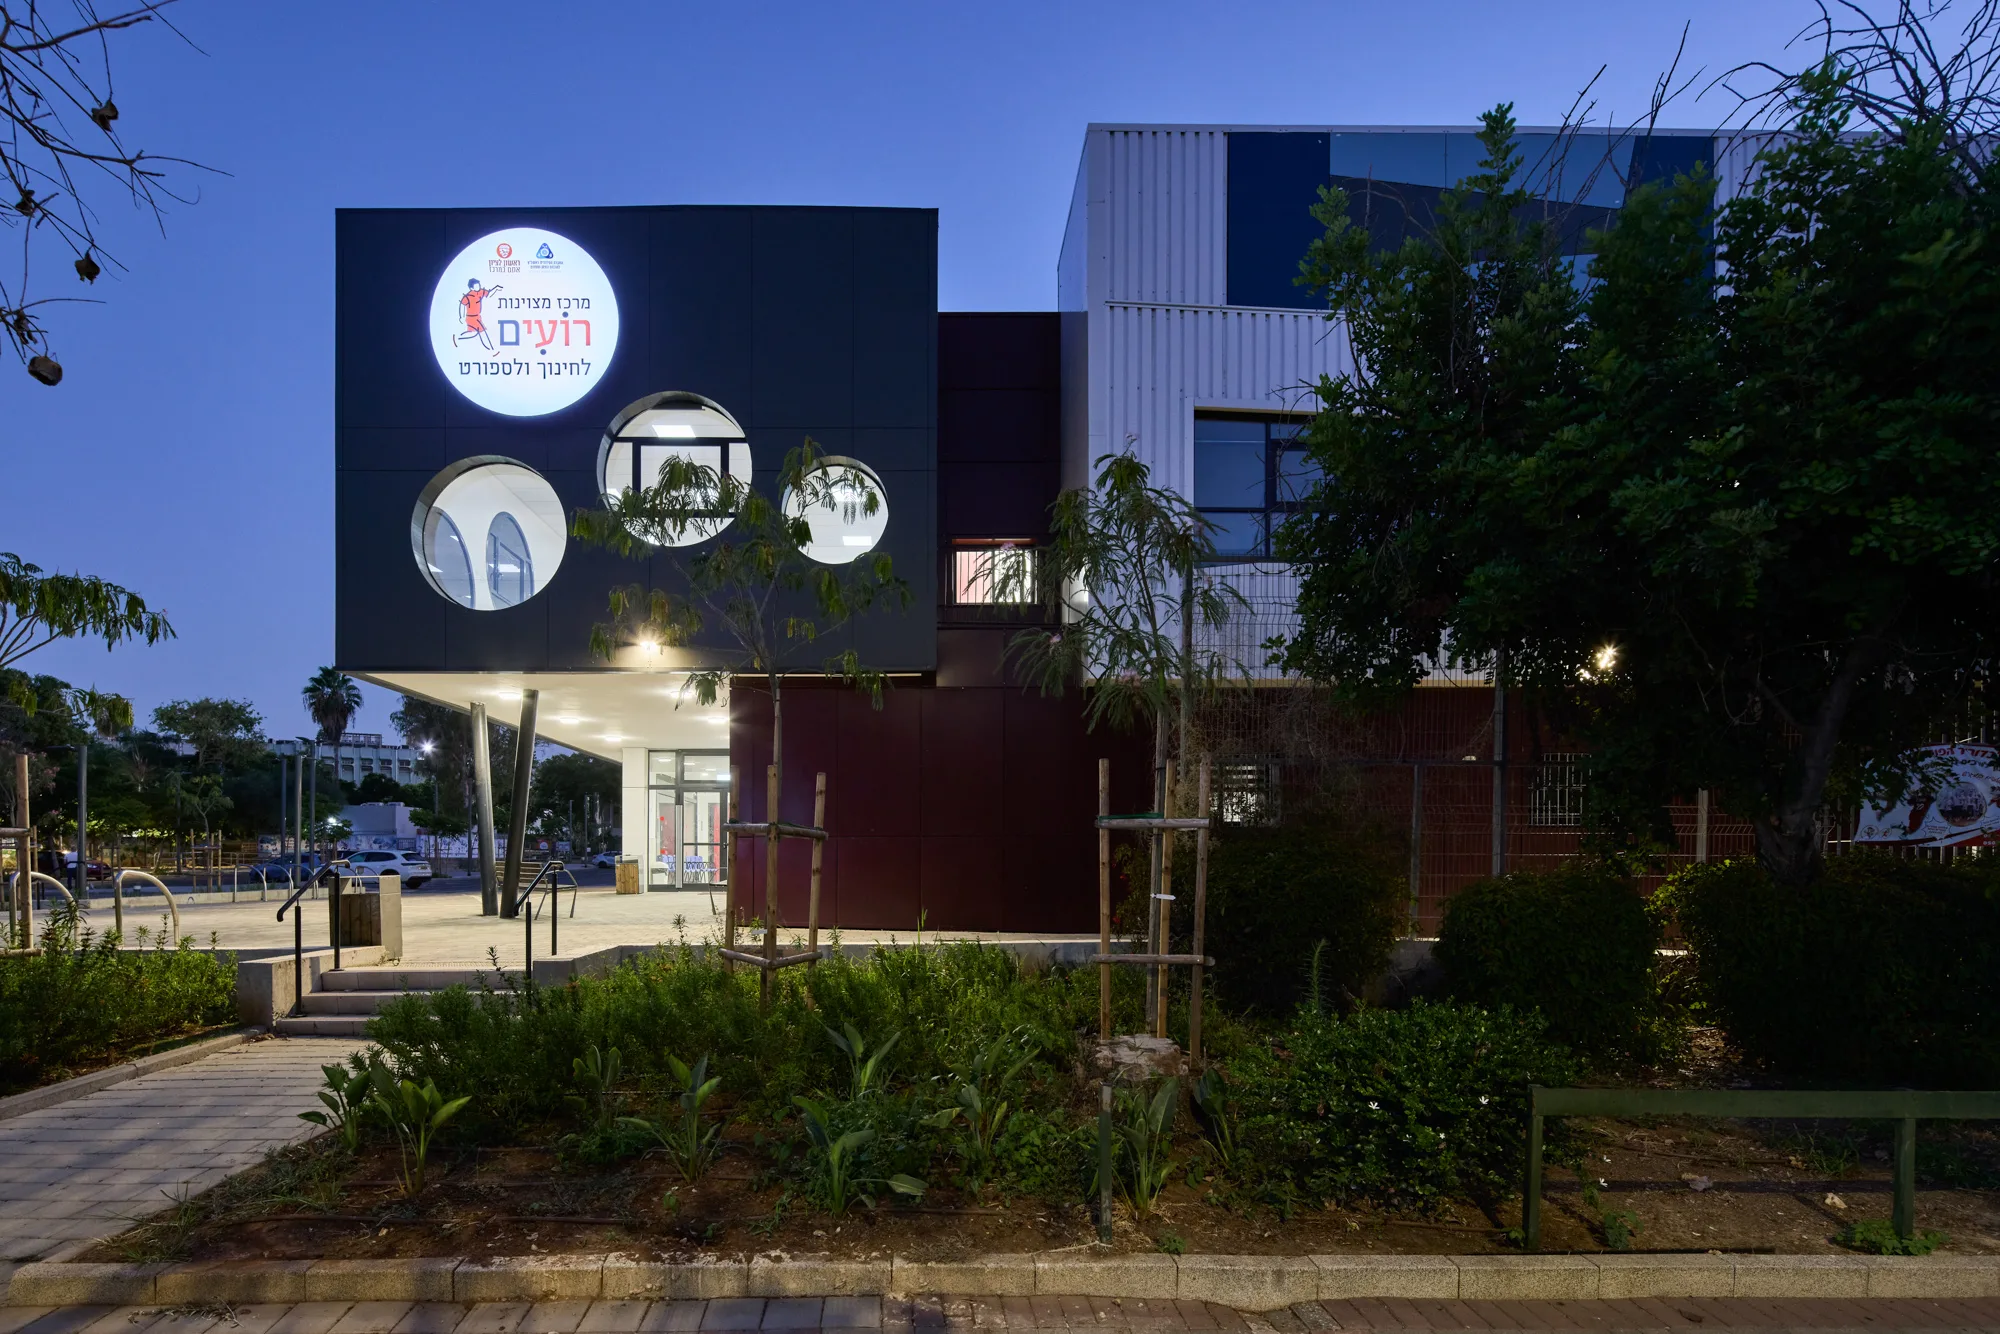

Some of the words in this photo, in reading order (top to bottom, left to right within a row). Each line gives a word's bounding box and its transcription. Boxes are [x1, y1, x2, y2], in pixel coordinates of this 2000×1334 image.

[498, 298, 552, 310] מצוינות
[557, 298, 591, 310] מרכז
[459, 358, 529, 376] ולספורט
[538, 358, 592, 379] לחינוך
